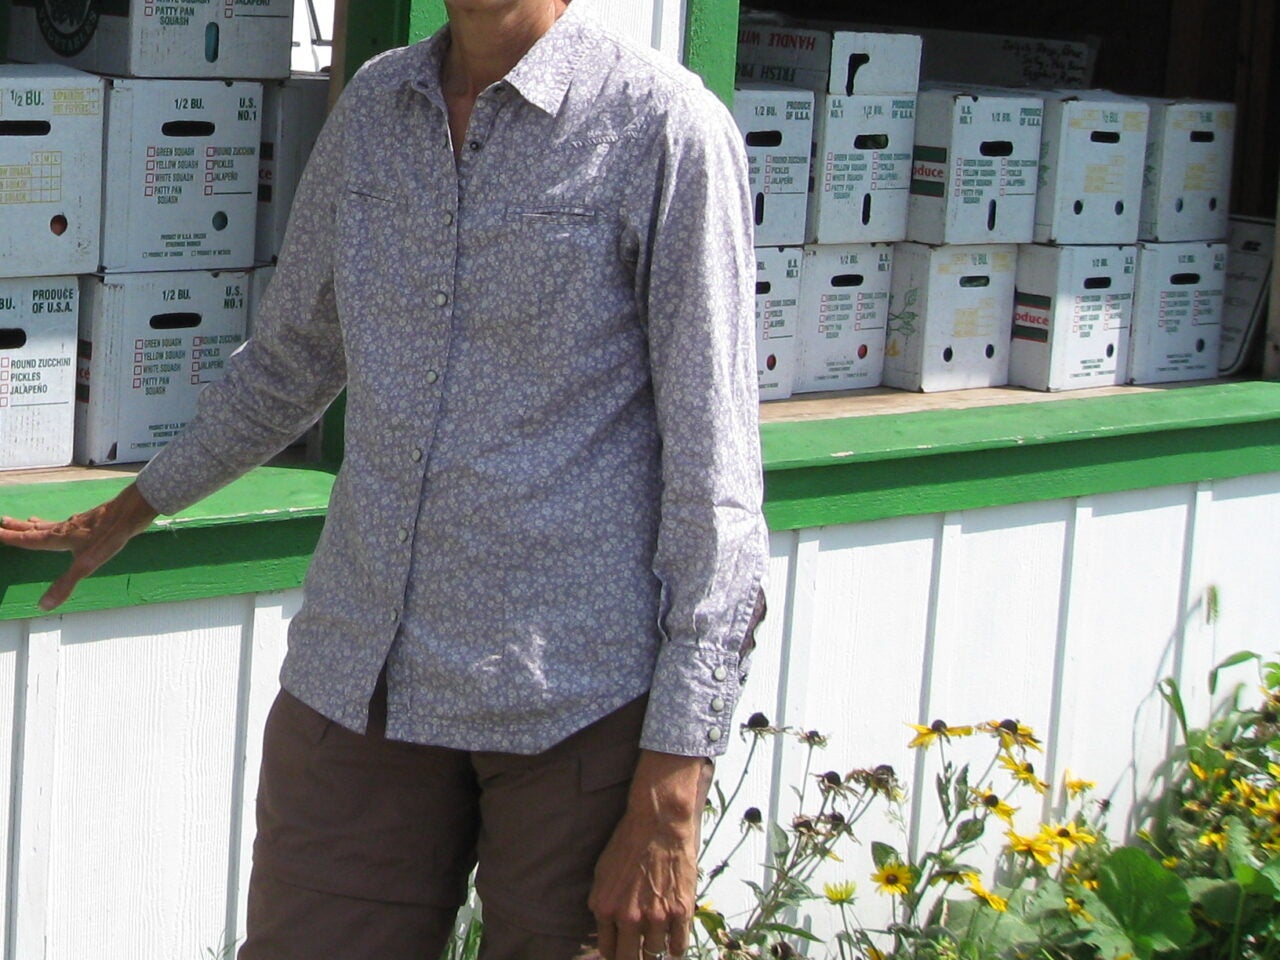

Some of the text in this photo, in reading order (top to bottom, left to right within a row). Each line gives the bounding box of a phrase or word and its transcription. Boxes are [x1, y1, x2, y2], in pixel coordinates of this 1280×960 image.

[155, 6, 194, 16] PATTY PAN
[160, 16, 189, 26] SQUASH
[768, 33, 816, 50] HANDLE
[25, 90, 44, 106] BU.
[175, 98, 205, 110] 1/2 BU.
[239, 98, 257, 109] U.S.
[156, 147, 194, 156] GREEN SQUASH
[156, 160, 198, 170] YELLOW SQUASH
[214, 160, 234, 169] PICKLES
[155, 173, 193, 182] WHITE SQUASH
[154, 186, 182, 195] PATTY PAN
[157, 196, 178, 204] SQUASH
[32, 288, 73, 301] PRODUCE
[162, 289, 191, 302] 1/2 BU.
[225, 286, 243, 296] U.S.
[32, 301, 72, 313] OF U.S.A.
[143, 351, 185, 361] YELLOW SQUASH
[11, 358, 71, 369] ROUND ZUCCHINI
[10, 372, 41, 382] PICKLES
[142, 377, 158, 386] PATTY
